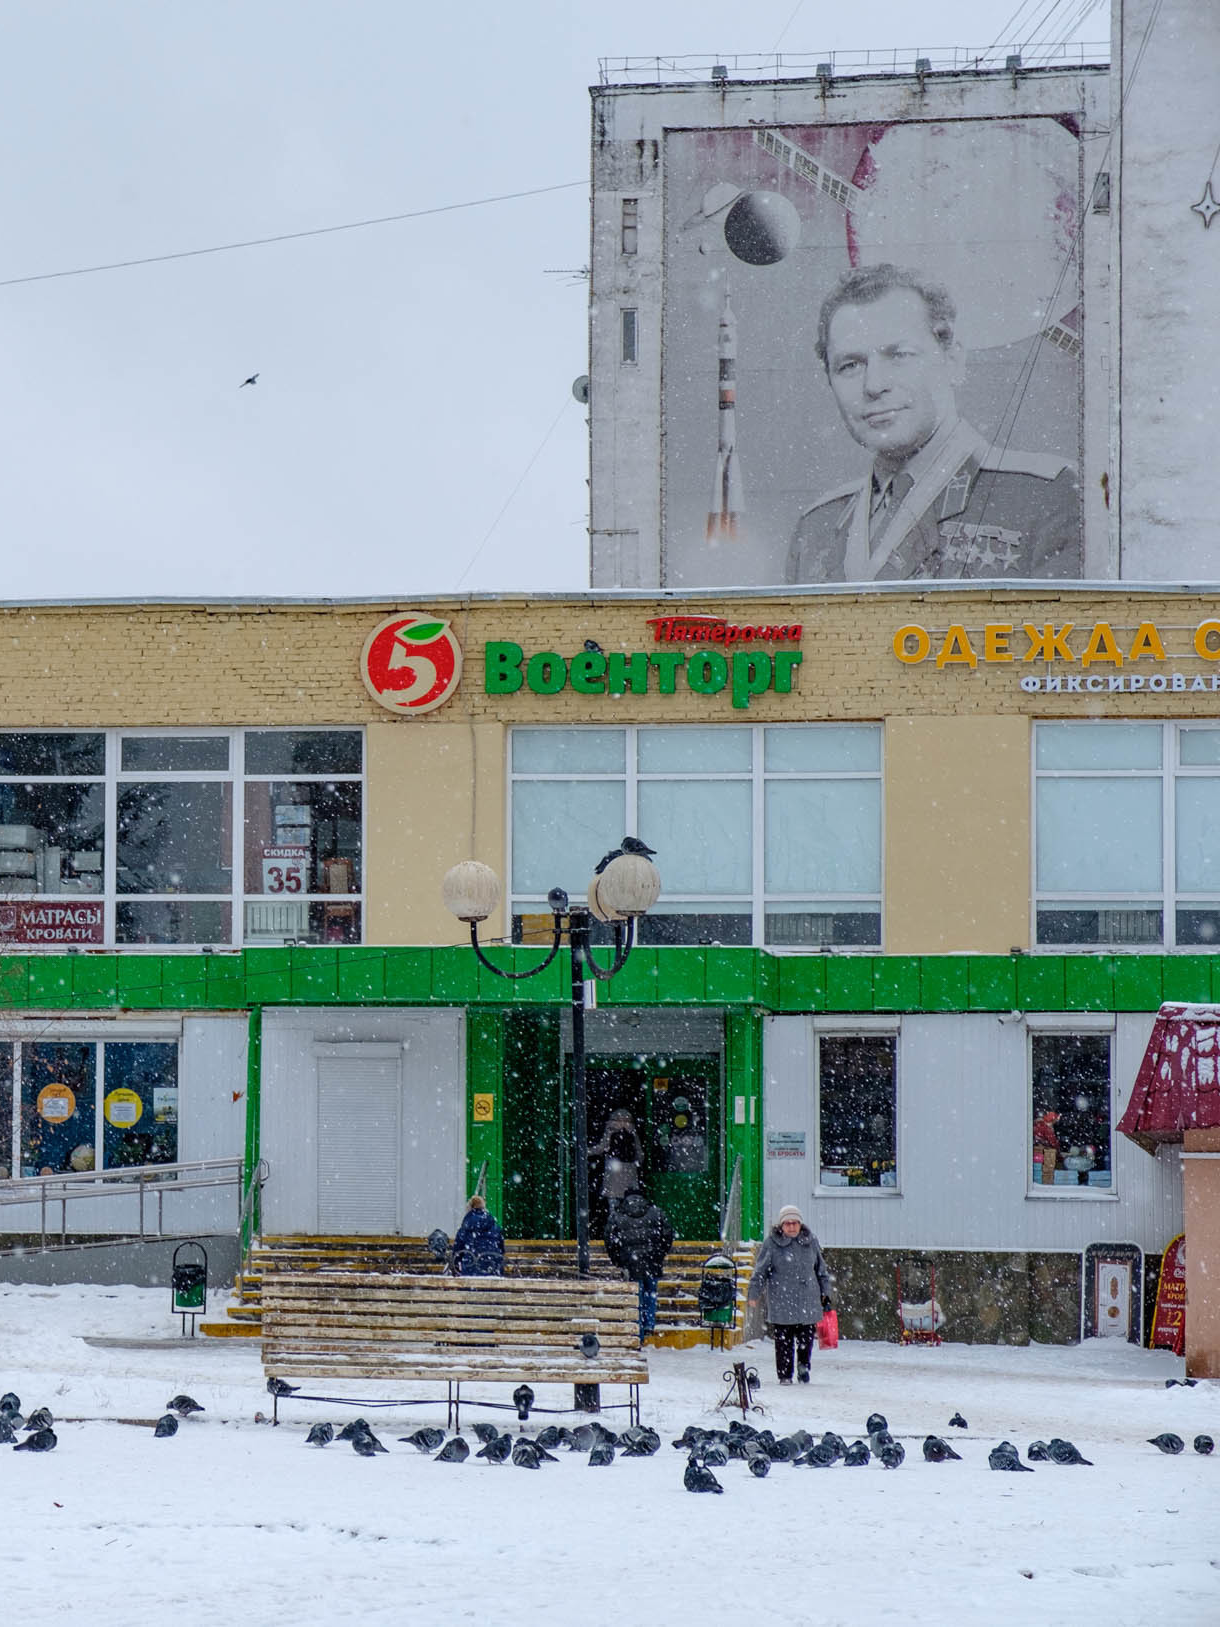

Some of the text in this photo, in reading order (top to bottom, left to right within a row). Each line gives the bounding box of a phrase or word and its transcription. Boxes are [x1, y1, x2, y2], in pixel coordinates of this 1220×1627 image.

[646, 614, 804, 648] Пятерочка
[892, 621, 1168, 669] ОДЕЖДА
[380, 640, 437, 704] 5
[484, 640, 804, 709] Военторг
[263, 848, 305, 858] СКИДКА
[267, 866, 302, 894] 35
[20, 908, 101, 926] МАТРАСЫ
[26, 927, 93, 940] КРОВАТИ
